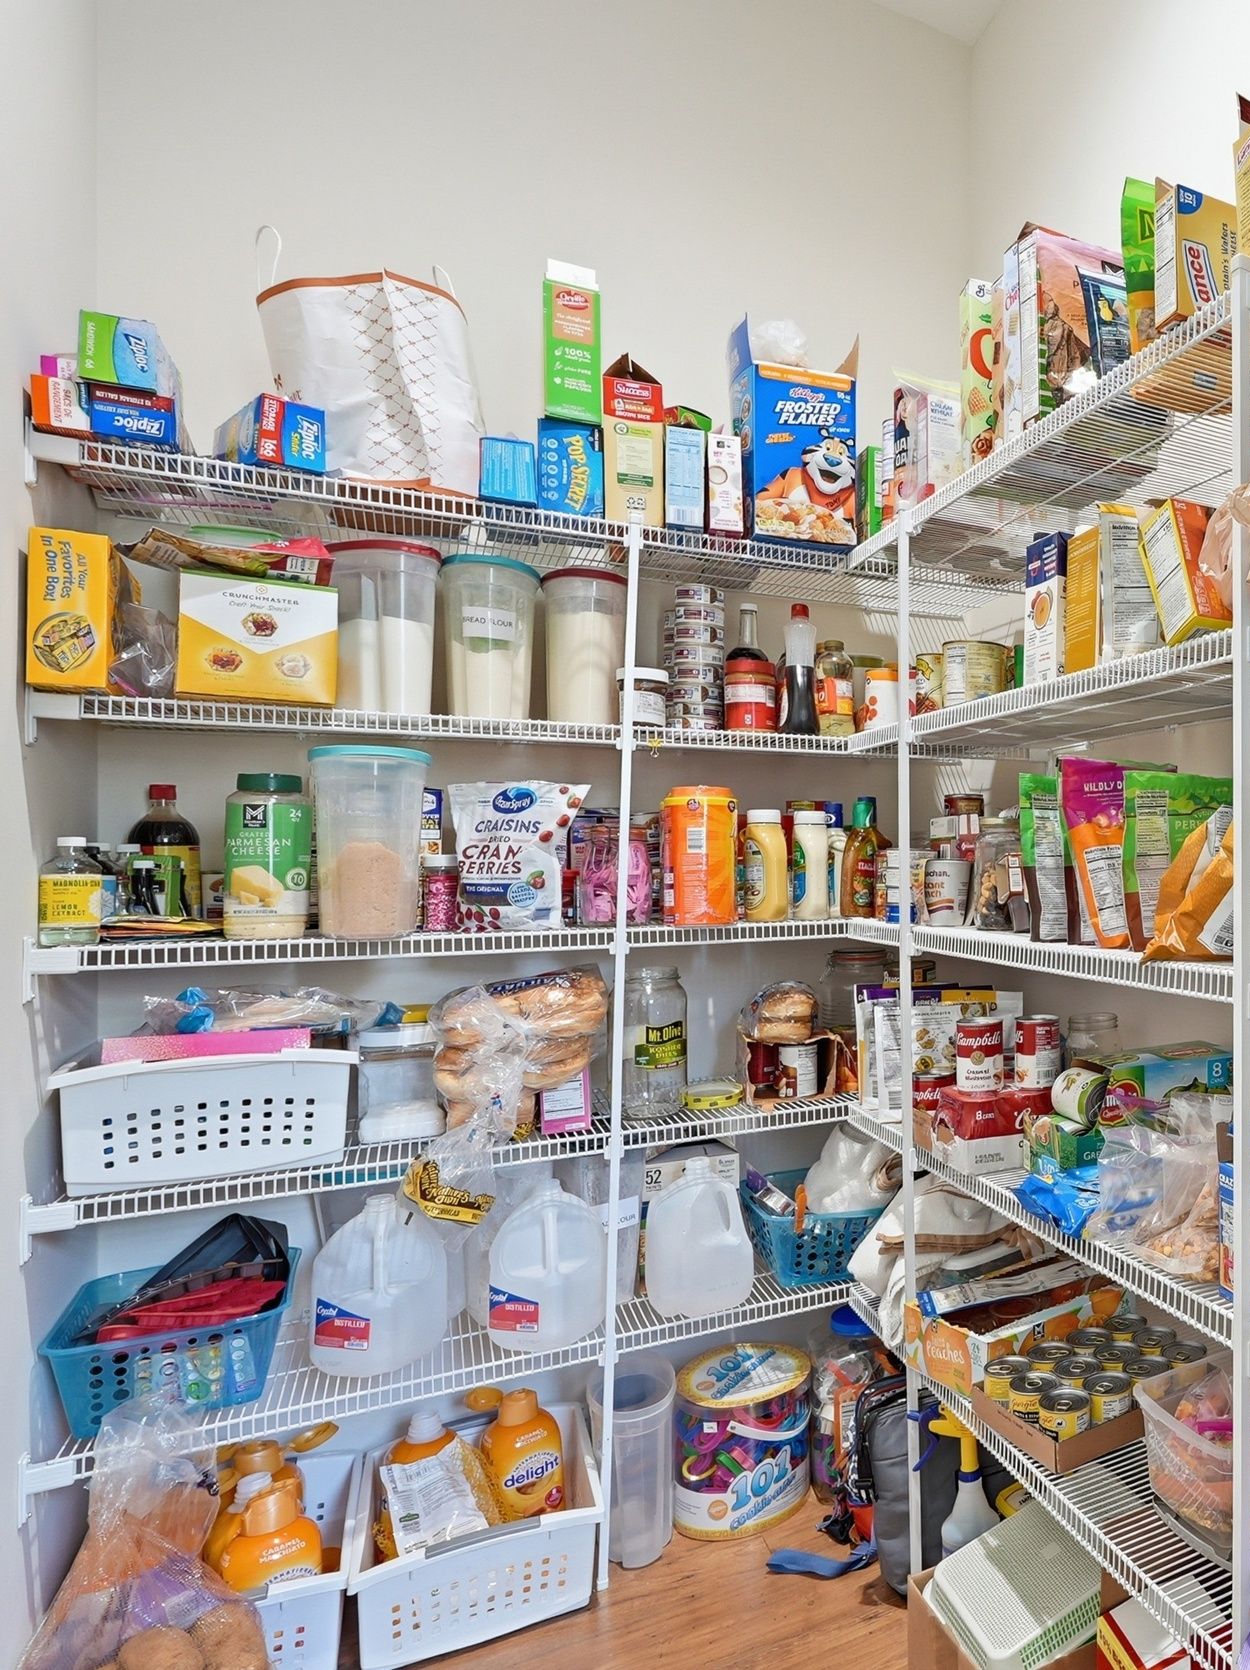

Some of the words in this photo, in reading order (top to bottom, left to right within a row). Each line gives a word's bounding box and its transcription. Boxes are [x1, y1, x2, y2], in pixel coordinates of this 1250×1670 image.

[1187, 245, 1213, 304] ance
[86, 321, 96, 356] SANDWICH
[127, 333, 149, 373] Ziploc
[564, 347, 592, 360] 100%
[85, 358, 95, 370] 66
[616, 382, 651, 397] Success
[775, 400, 841, 415] FROSTED
[113, 415, 161, 435] Ziploc
[779, 412, 836, 426] FLAKES
[300, 418, 319, 461] Ziploc
[264, 439, 277, 457] 166
[40, 535, 53, 546] In
[45, 550, 58, 573] One
[58, 540, 75, 599] Favorites
[77, 568, 88, 591] Your
[43, 576, 59, 602] Box!
[222, 591, 300, 606] CRUNCHMASTER
[463, 616, 486, 625] BREAD
[490, 618, 514, 628] LOUR
[1083, 781, 1115, 793] WILDLY
[474, 819, 541, 834] CRAISINS
[226, 838, 292, 848] PARMESAN
[231, 846, 281, 855] CHEESE
[458, 861, 522, 876] BERRIES
[52, 903, 78, 911] LEMON
[52, 910, 86, 918] EXTRACT
[648, 1028, 662, 1043] Mt.
[662, 1025, 683, 1039] Olive
[1212, 1062, 1223, 1077] 8
[976, 1111, 983, 1121] 8
[645, 1169, 662, 1185] 52
[504, 1304, 535, 1313] DISTILLED
[334, 1319, 367, 1329] DISTILLED
[926, 1338, 965, 1366] Peaches
[706, 1347, 754, 1383] 101
[503, 1453, 560, 1490] delight
[730, 1447, 791, 1513] 101
